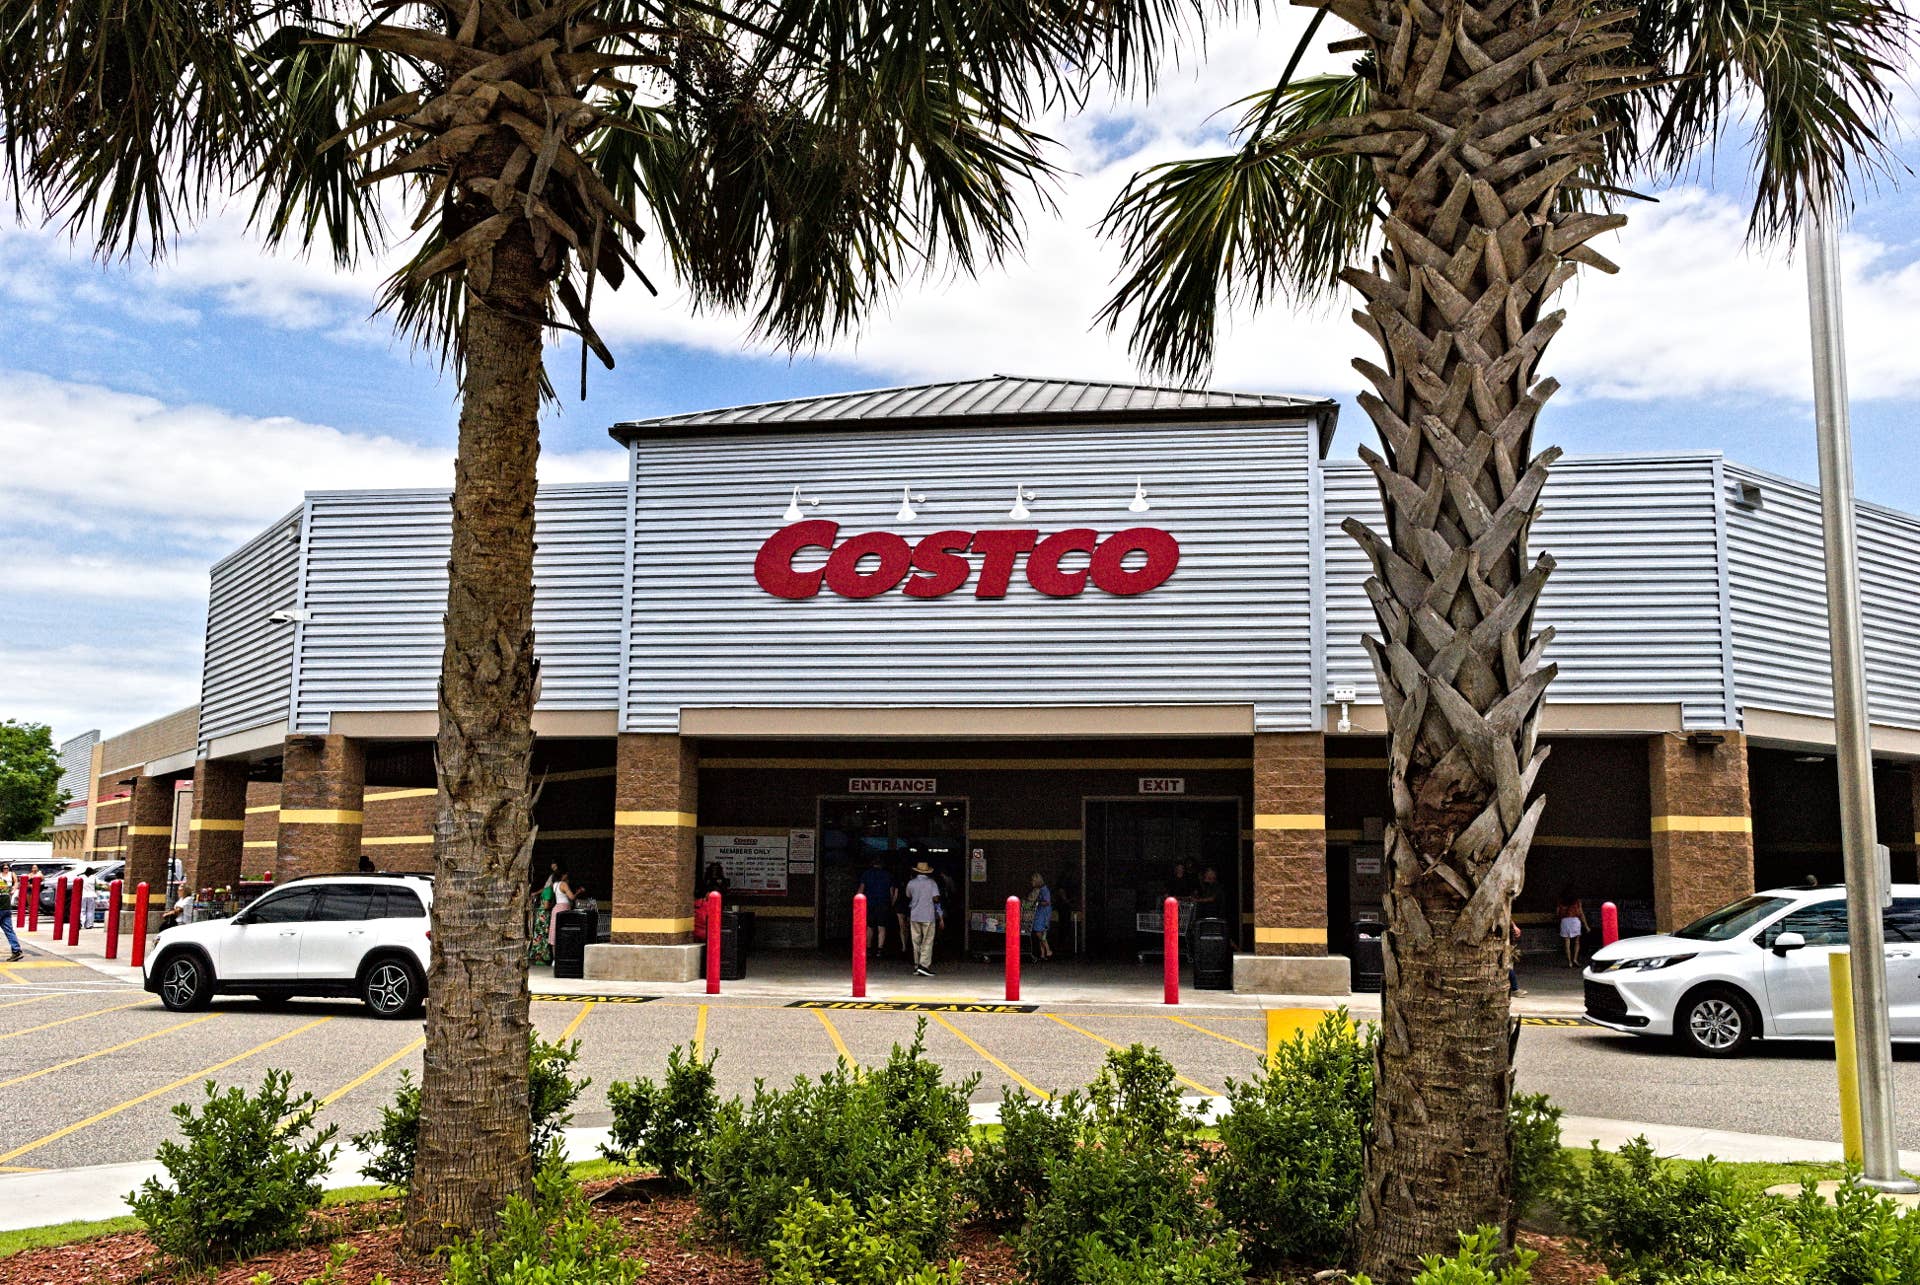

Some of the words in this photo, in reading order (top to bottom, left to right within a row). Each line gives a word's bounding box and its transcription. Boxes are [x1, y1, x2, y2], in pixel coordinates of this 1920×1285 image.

[754, 519, 1180, 599] COSTCO
[851, 780, 934, 792] ENTRANCE
[1143, 780, 1180, 791] EXIT
[799, 1001, 900, 1010] FIRE
[903, 1003, 1023, 1013] LANE
